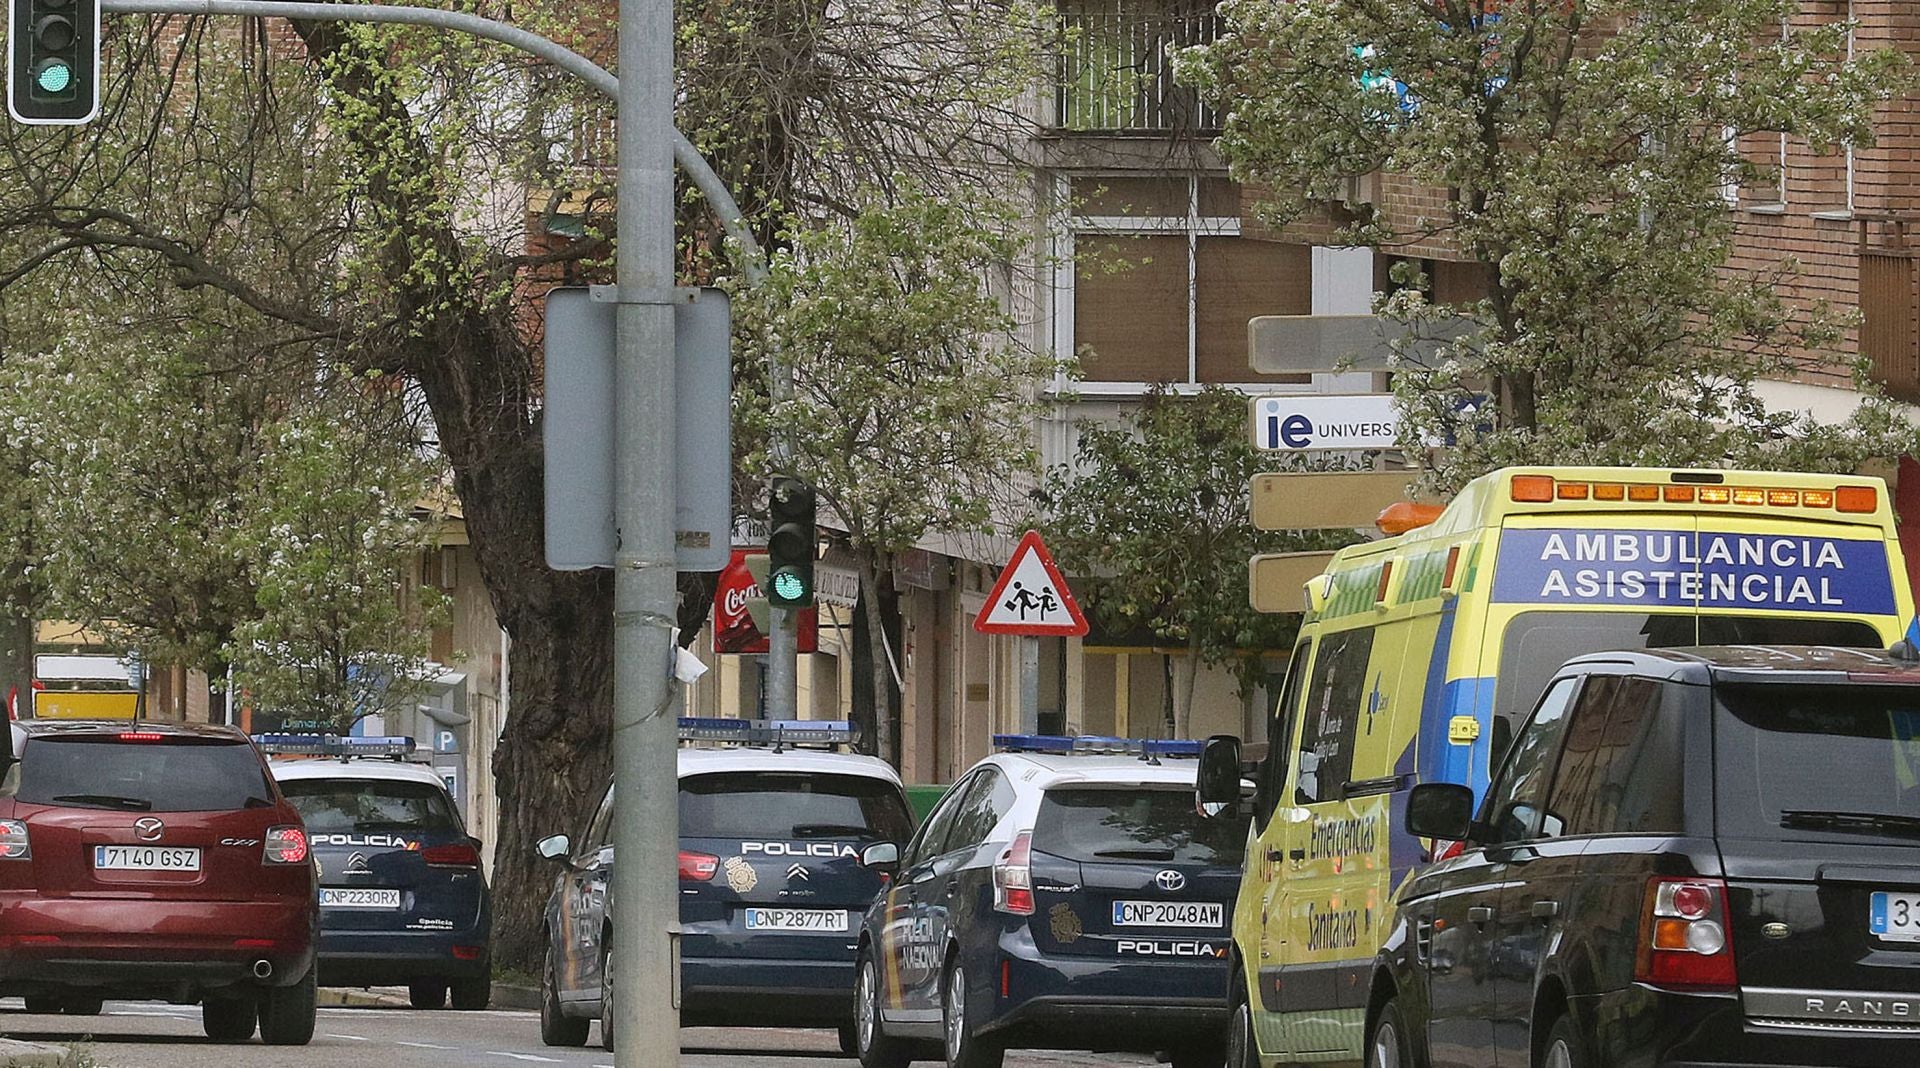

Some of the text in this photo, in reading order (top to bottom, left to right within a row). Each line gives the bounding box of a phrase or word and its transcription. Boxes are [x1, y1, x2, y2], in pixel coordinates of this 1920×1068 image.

[1266, 400, 1313, 448] ie
[1541, 534, 1844, 568] AMBULANCIA
[1541, 569, 1843, 605] ASISTENCIAL
[311, 834, 408, 847] POLICÍA
[741, 842, 859, 857] POLICÍA
[1310, 813, 1376, 873] Emergencias
[109, 849, 195, 867] 7140 GSZ
[1308, 901, 1357, 951] Sanitarias
[1117, 941, 1215, 956] POLICÍA
[1806, 999, 1920, 1016] RANG
